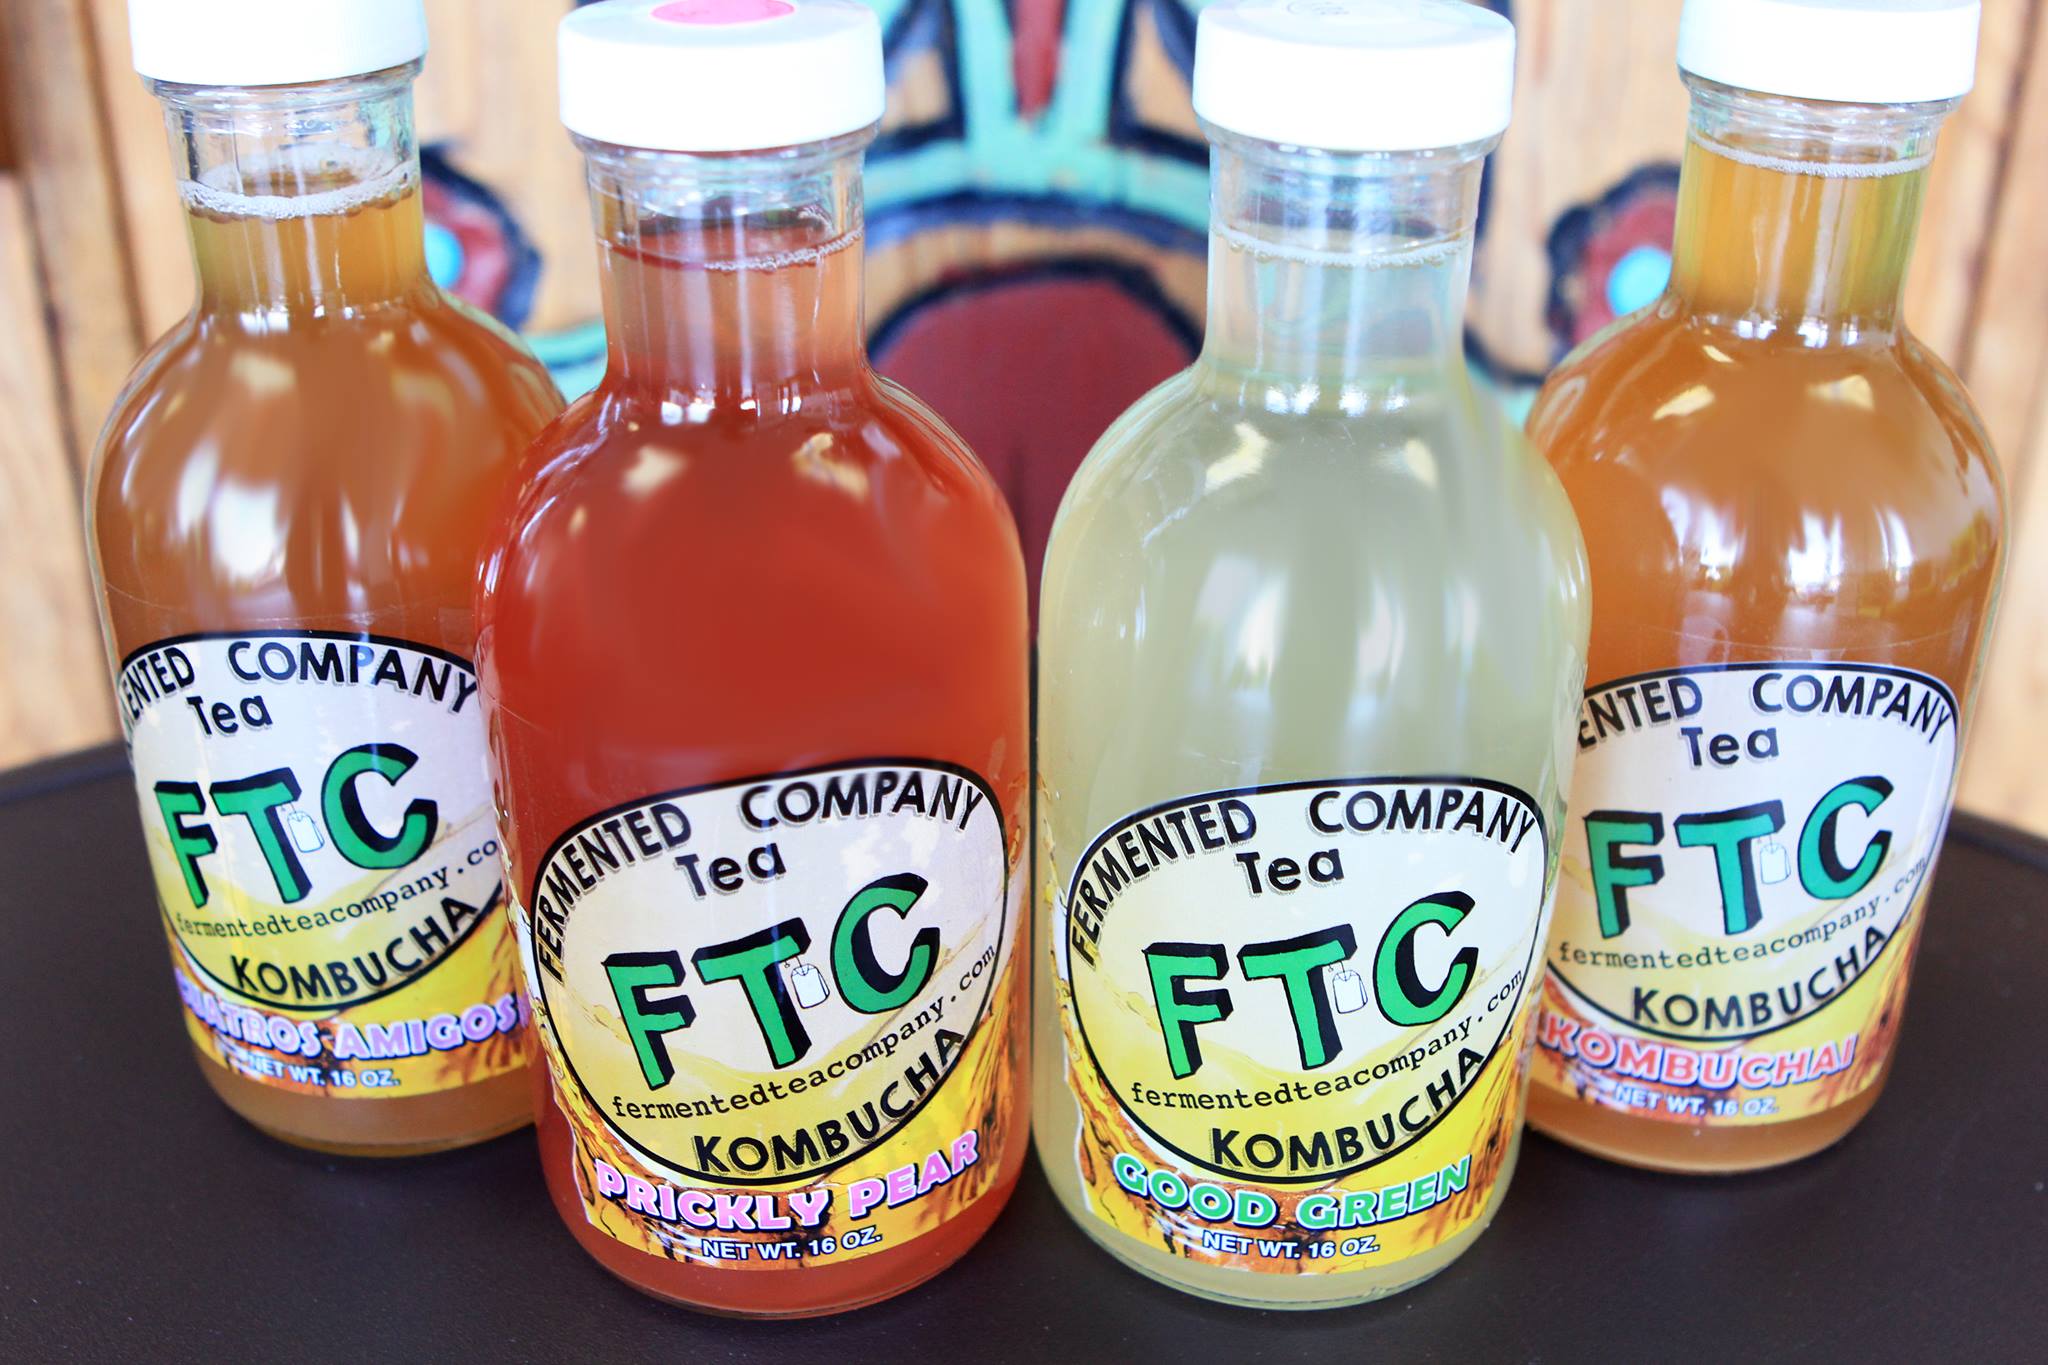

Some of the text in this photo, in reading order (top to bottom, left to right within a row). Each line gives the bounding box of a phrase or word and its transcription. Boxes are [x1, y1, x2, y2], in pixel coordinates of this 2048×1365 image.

[122, 641, 478, 722] ENTED COMPANY
[187, 695, 273, 735] Tea
[1577, 673, 1952, 749] ENTED COMPANY
[1680, 726, 1780, 767] Tea
[154, 743, 438, 908] FTC
[1584, 774, 1895, 940] FTC
[176, 839, 498, 938] fermentedteacompany.co
[538, 770, 985, 984] FERMENTED COMPANY
[675, 842, 788, 898] Tea
[1071, 788, 1536, 968] FERMENTED COMPANY
[1235, 848, 1345, 896] Tea
[230, 897, 479, 1000] KOMBUCHA
[602, 871, 940, 1091] FTC
[1142, 890, 1479, 1080] FTC
[1632, 924, 1887, 1031] KOMBUCHA
[333, 992, 519, 1062] AMIGOS
[1543, 1011, 1859, 1091] KOMBUCHAI
[248, 1052, 402, 1088] NET WT. 16 OZ.
[693, 1027, 965, 1176] KOMBUCHA
[1210, 1046, 1486, 1174] KOMBUCHA
[1615, 1082, 1661, 1110] NET
[1666, 1095, 1707, 1116] WT.
[1713, 1098, 1739, 1116] 16
[593, 1129, 980, 1234] PRICKLY PEAR
[1112, 1151, 1473, 1232] GOOD GREEN
[702, 1226, 883, 1261] NET WT. 16 OZ.
[1203, 1230, 1381, 1260] NET WT. 16 OZ.
